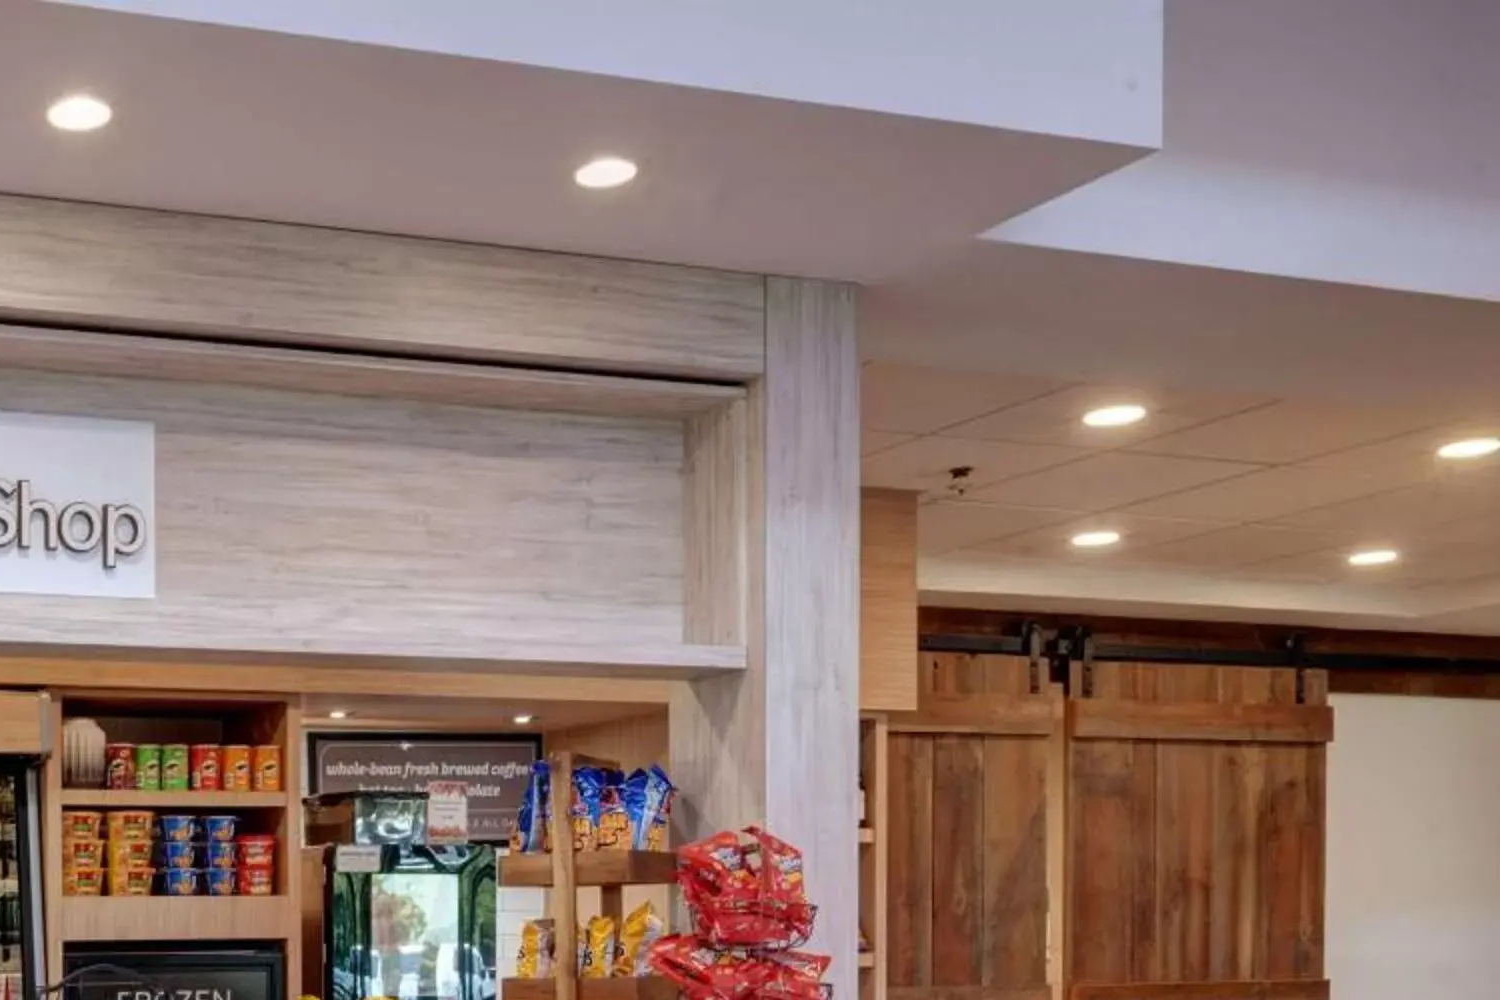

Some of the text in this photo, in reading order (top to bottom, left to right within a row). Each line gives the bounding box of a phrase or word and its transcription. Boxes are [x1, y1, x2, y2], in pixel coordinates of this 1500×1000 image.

[326, 761, 528, 779] whole-bean fresh brewed coffee
